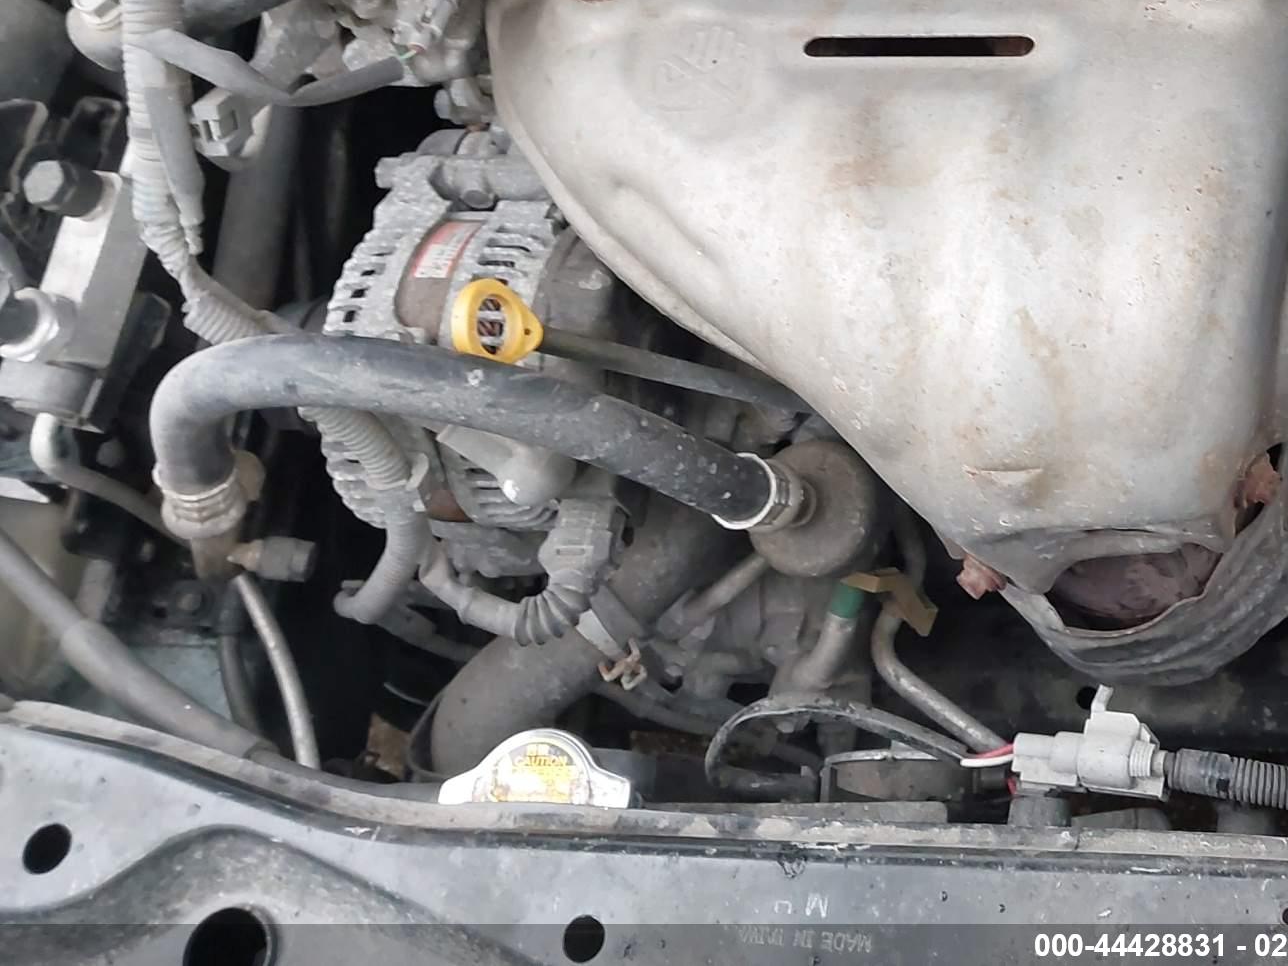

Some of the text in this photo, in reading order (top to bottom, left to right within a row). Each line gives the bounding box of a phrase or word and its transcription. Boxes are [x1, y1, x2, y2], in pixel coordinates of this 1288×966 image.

[513, 755, 568, 767] CAUTION
[793, 930, 815, 948] IN
[821, 931, 872, 953] MADE
